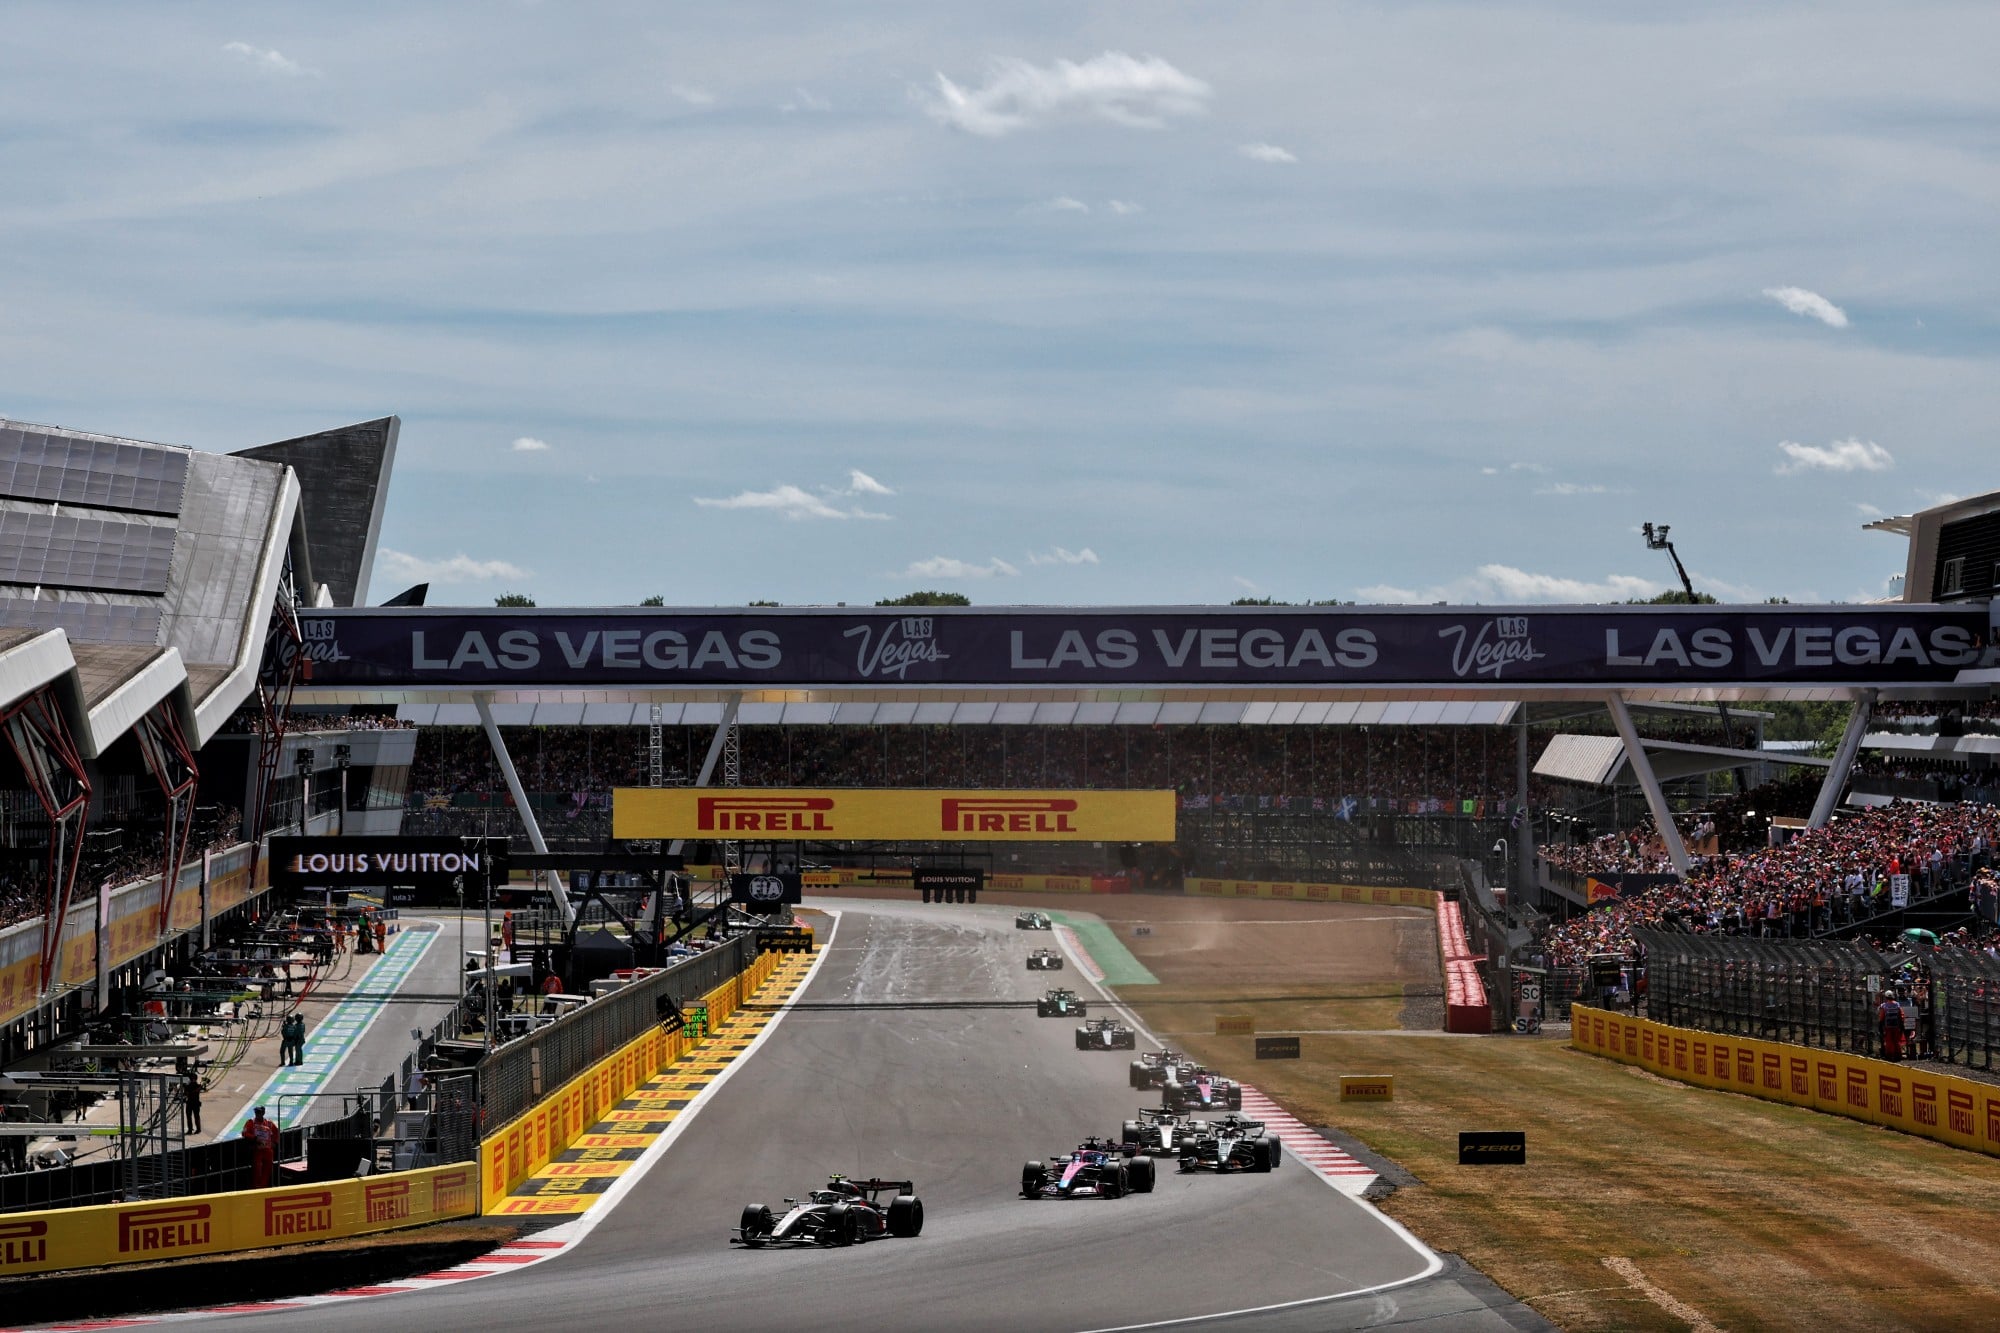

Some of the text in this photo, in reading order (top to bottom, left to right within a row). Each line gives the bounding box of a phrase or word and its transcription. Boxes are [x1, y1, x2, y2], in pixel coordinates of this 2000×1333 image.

[305, 621, 334, 639] LAS
[902, 618, 932, 638] LAS
[1498, 617, 1528, 637] LAS
[1605, 626, 1975, 668] LAS VEGAS
[412, 630, 782, 669] LAS VEGAS
[843, 621, 950, 679] Vegas
[1010, 628, 1378, 669] LAS VEGAS
[1438, 621, 1545, 678] Vegas
[298, 852, 479, 873] LOUIS VUITTON
[944, 876, 976, 884] VUITTON
[751, 879, 782, 897] FIA
[1522, 988, 1539, 1000] SC
[1346, 1084, 1387, 1095] PIRELLI
[1847, 1067, 1868, 1108] PIRELLI
[1879, 1075, 1902, 1117] PIRELLI
[1912, 1082, 1937, 1126] PIRELLI
[1948, 1088, 1974, 1136] PIRELLI
[1477, 1144, 1522, 1152] ZERO
[365, 1180, 409, 1223] PIRELLI
[433, 1172, 466, 1212] PIRELLI
[119, 1203, 211, 1252] PIRELLI
[265, 1191, 332, 1236] PIRELLI
